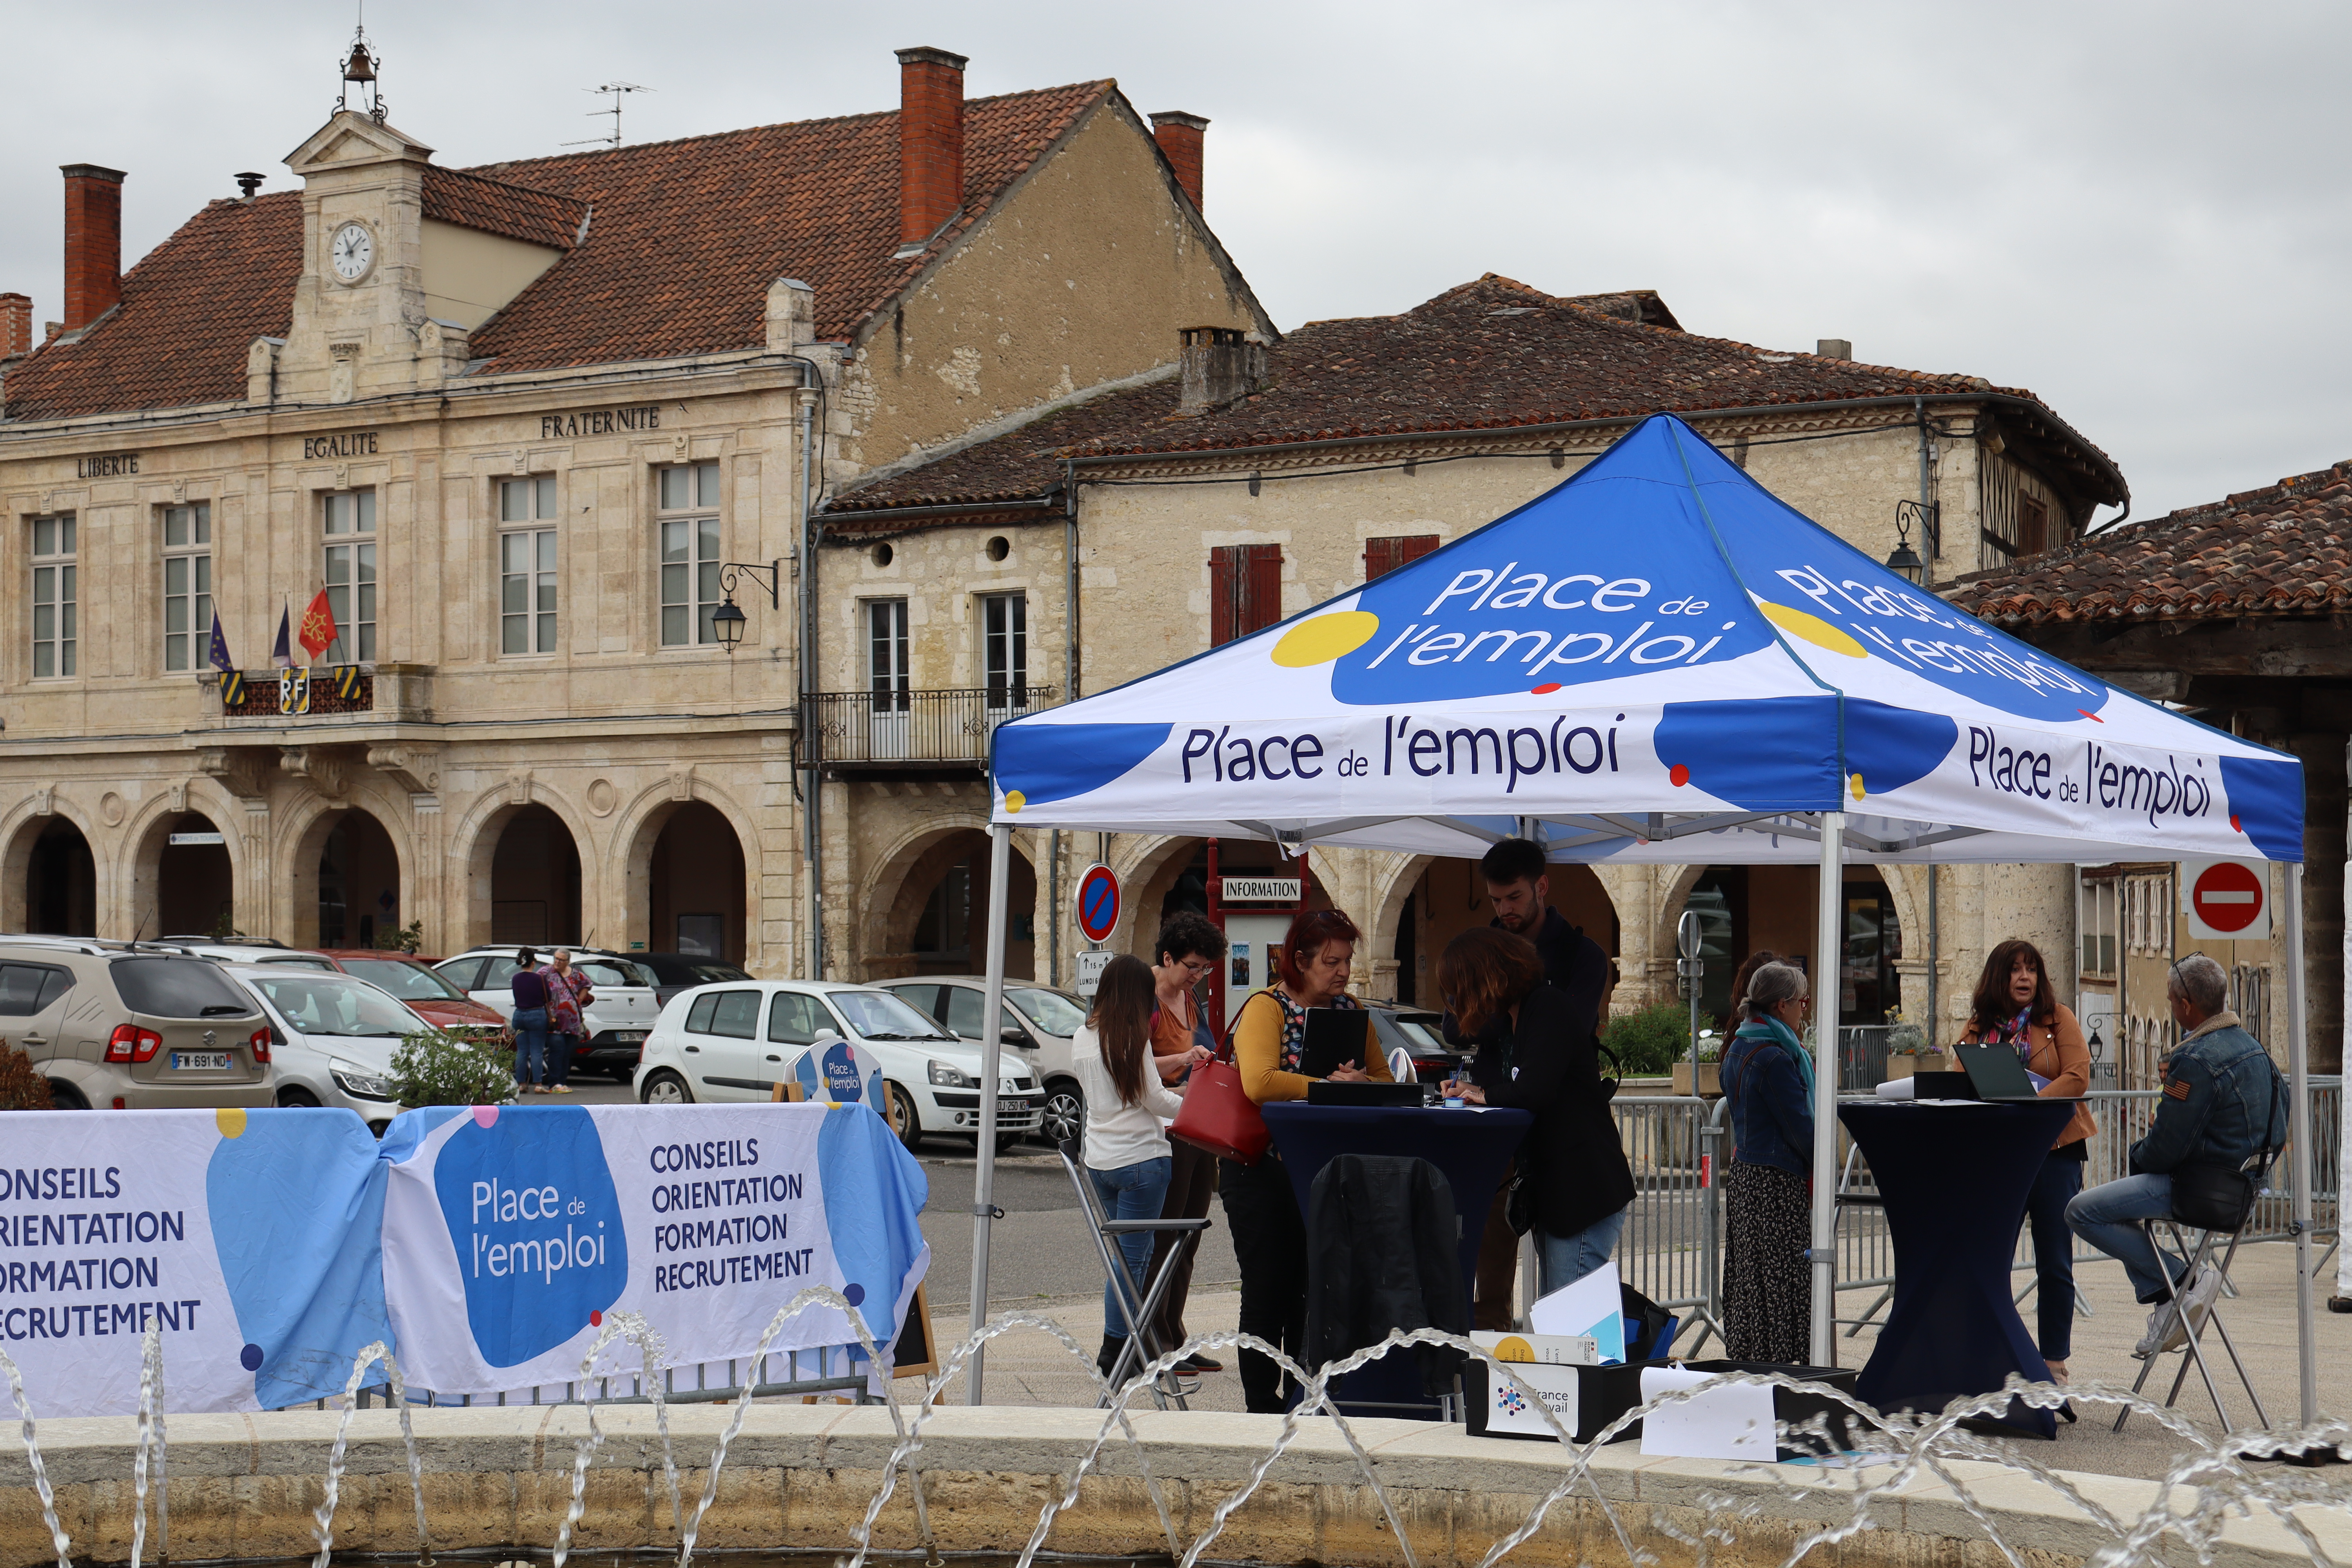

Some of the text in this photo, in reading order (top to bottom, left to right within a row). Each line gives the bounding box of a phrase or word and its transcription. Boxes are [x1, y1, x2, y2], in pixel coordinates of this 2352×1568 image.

[541, 407, 660, 438] FRATERNITE
[304, 432, 378, 459] EGALITE
[78, 454, 139, 478] LIBERTE
[1422, 561, 1710, 615] Place de
[1774, 565, 1993, 639] Place de
[1366, 621, 1736, 676] l'emploi
[1849, 623, 2099, 697] l'emploi
[282, 679, 305, 701] RF
[1181, 713, 1626, 794] Place de l'emploi
[1969, 726, 2210, 829] Place de l'emploi
[1226, 882, 1297, 897] INFORMATION
[178, 1055, 226, 1067] FW-691-ND
[829, 1062, 849, 1074] Place
[830, 1076, 860, 1093] l'emploi
[650, 1138, 758, 1173] CONSEILS
[472, 1177, 586, 1225] Place de
[652, 1173, 802, 1213] ORIENTATION
[473, 1220, 606, 1285] l'emploi
[655, 1213, 788, 1253] FORMATION
[655, 1248, 813, 1293] RECRUTEMENT
[0, 1300, 201, 1341] CRUTEMENT
[1534, 1389, 1568, 1401] rance
